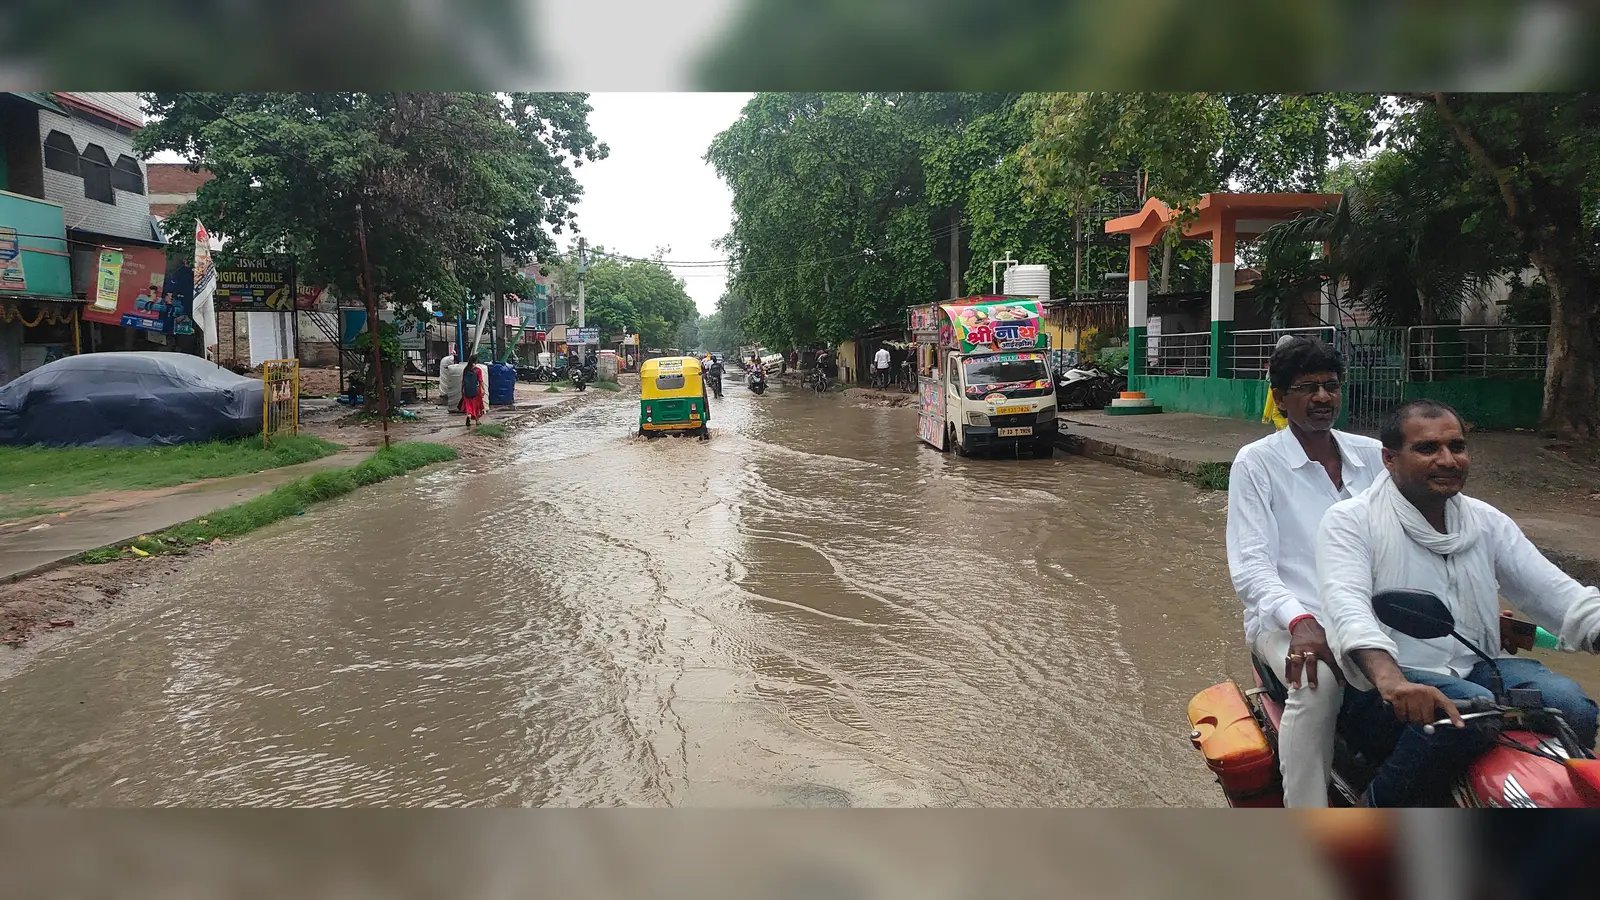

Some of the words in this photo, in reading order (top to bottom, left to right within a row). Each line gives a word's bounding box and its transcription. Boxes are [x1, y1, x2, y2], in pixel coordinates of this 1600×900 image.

[216, 271, 249, 283] DIGITAL
[250, 271, 284, 283] MOBILE
[967, 325, 992, 344] श्री
[994, 326, 1035, 339] नाथ
